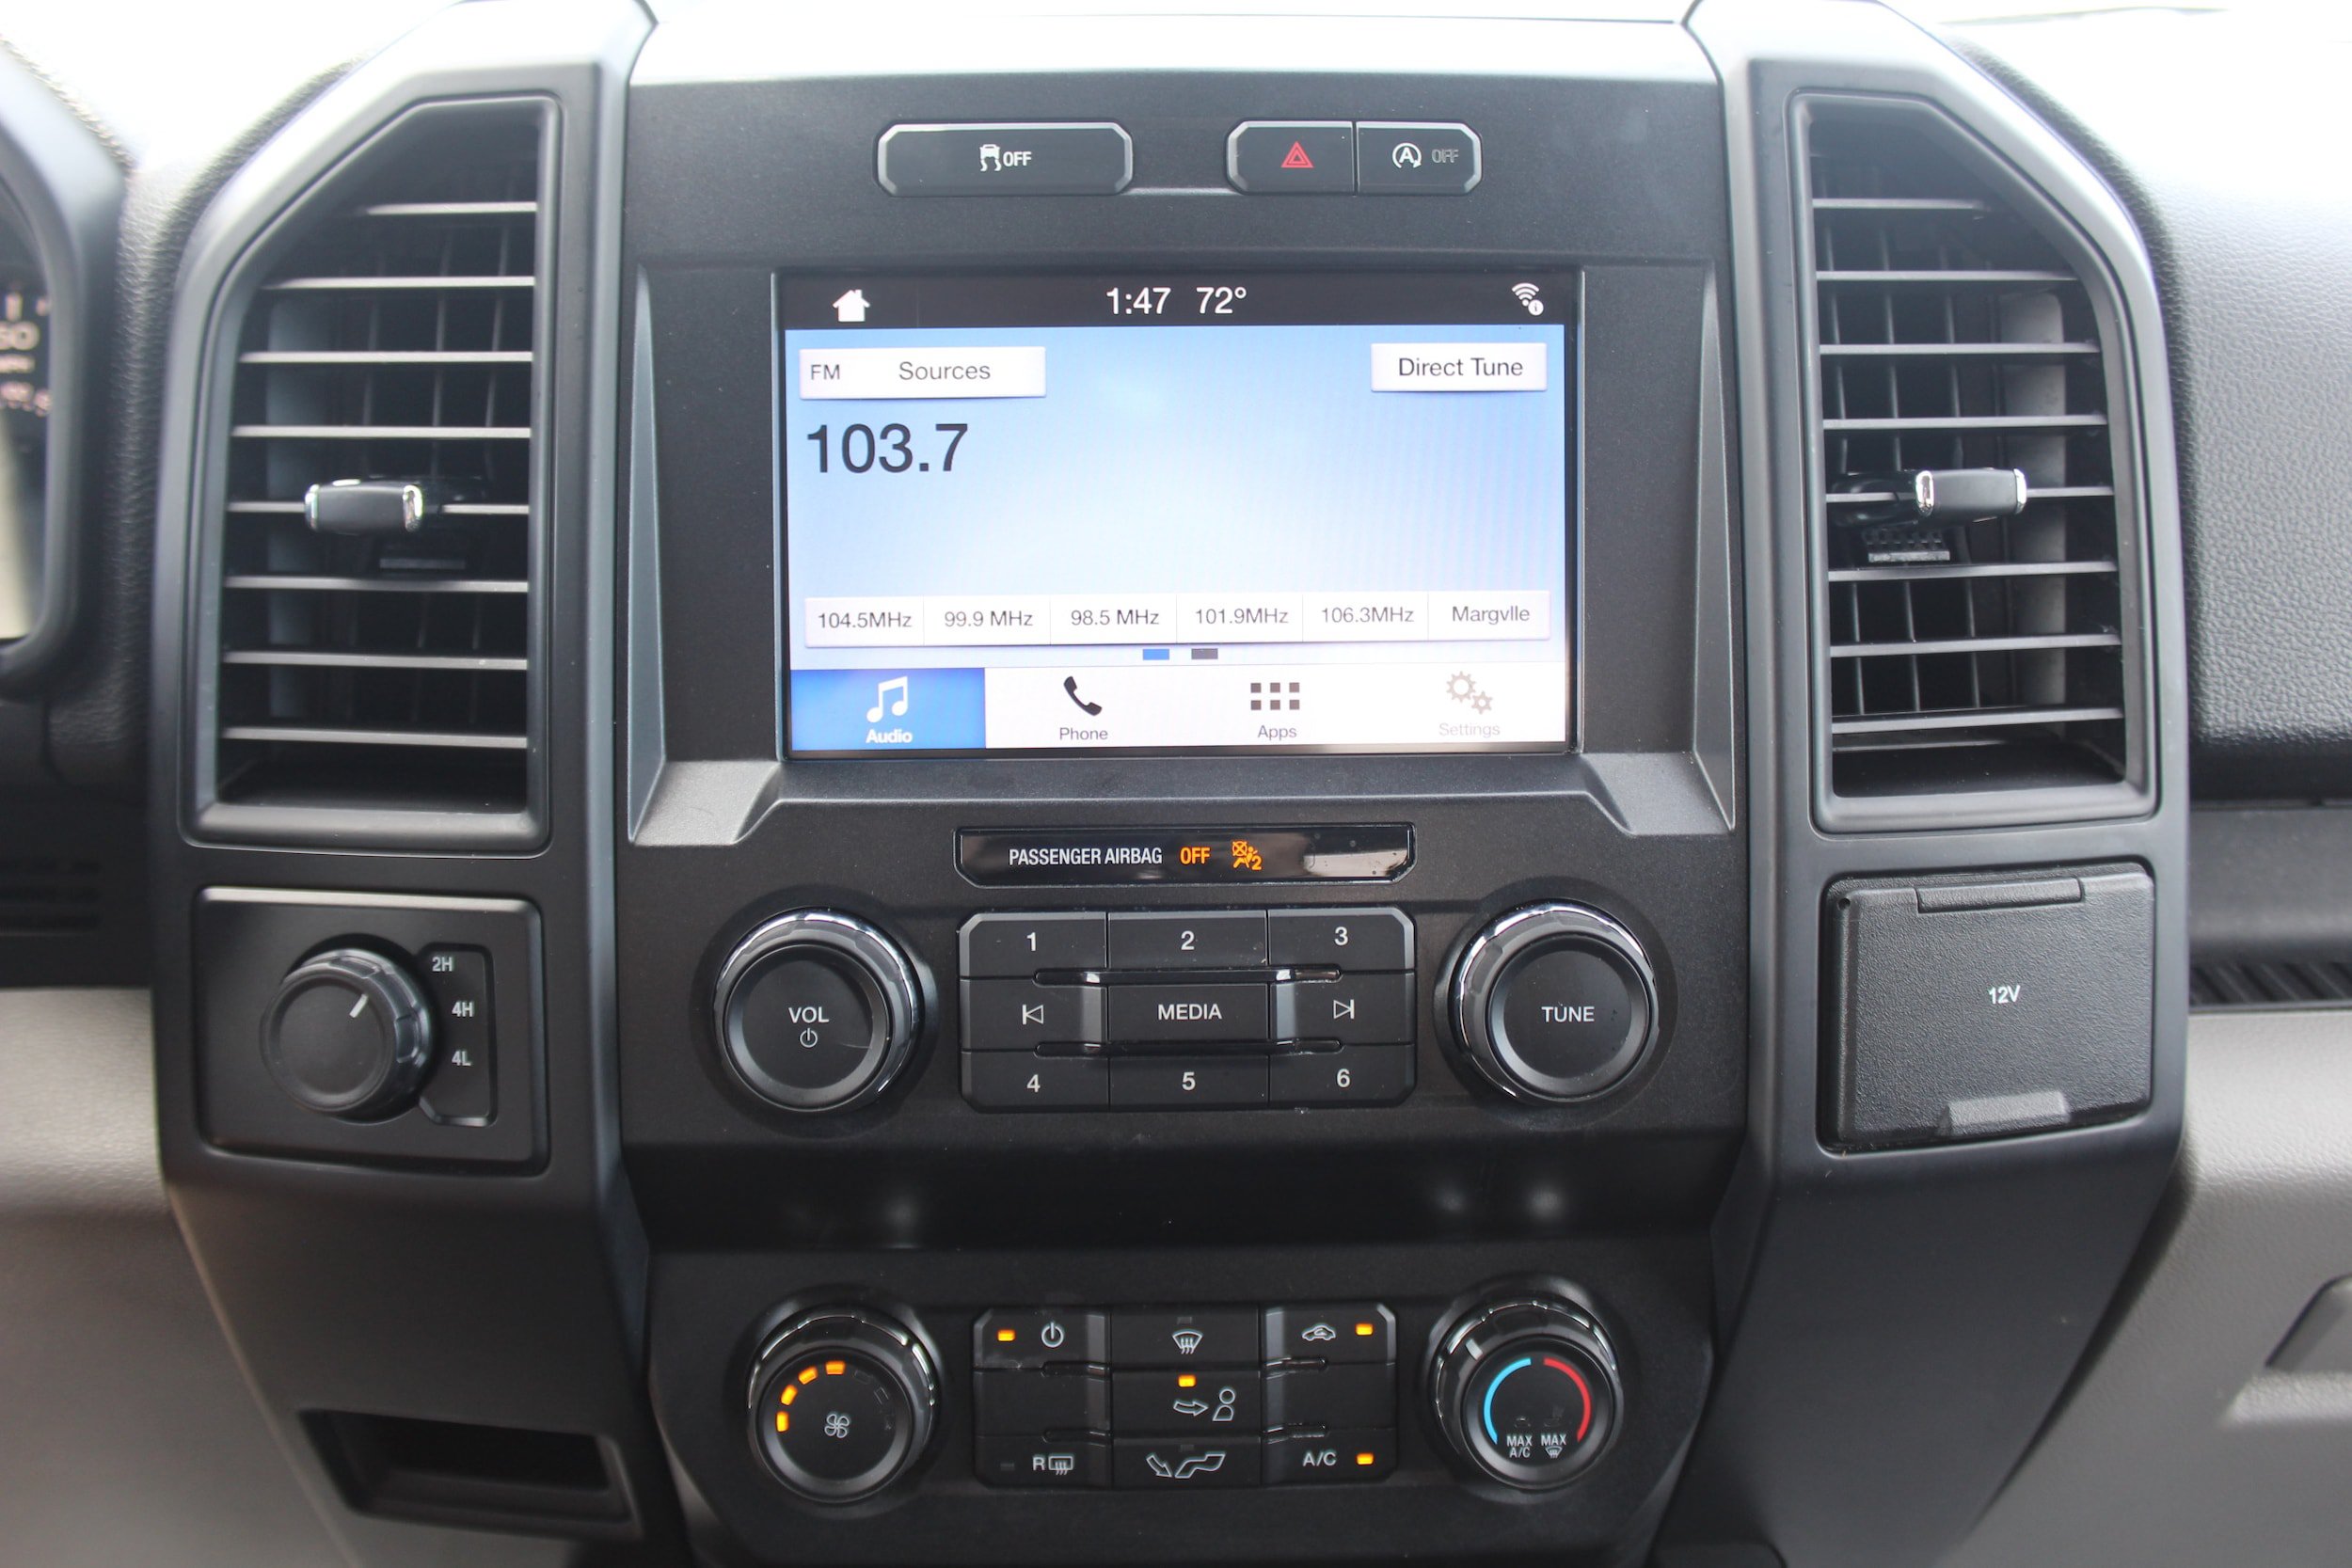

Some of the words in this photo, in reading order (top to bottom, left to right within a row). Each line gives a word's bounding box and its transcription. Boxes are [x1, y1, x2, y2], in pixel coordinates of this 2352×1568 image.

[1004, 151, 1032, 168] OFF
[1431, 149, 1459, 164] OFF
[1107, 287, 1171, 315] 1:47
[1196, 286, 1247, 315] 72°
[811, 363, 840, 380] FM
[898, 361, 991, 381] Sources
[1398, 356, 1464, 377] Direct
[1471, 356, 1523, 377] Tune
[807, 422, 969, 474] 103.7
[818, 611, 913, 629] 104.5MHz
[944, 610, 984, 627] 99.9
[990, 610, 1034, 627] MHz
[1070, 610, 1111, 626] 98.5
[1117, 610, 1160, 626] MHz
[1195, 608, 1289, 625] 101.9MHz
[1321, 607, 1415, 624] 106.3MHz
[1452, 605, 1531, 626] Margvlle
[866, 728, 914, 745] Audio
[1058, 726, 1109, 742] Phone
[1257, 723, 1297, 742] Apps
[1438, 722, 1501, 739] Settings
[1009, 847, 1102, 867] PASSENGER
[1104, 846, 1163, 865] AIRBAG
[1179, 847, 1212, 865] OFF
[1026, 932, 1038, 952] 1
[1181, 930, 1196, 951] 2
[1334, 927, 1349, 946] 3
[431, 956, 453, 973] 2H
[1987, 984, 2022, 1006] 12V
[451, 1001, 475, 1018] 4H
[787, 1006, 830, 1024] VOL
[1157, 1003, 1223, 1022] MEDIA
[1541, 1005, 1596, 1023] TUNE
[451, 1050, 472, 1067] 4L
[1026, 1074, 1041, 1094] 4
[1182, 1072, 1196, 1092] 5
[1336, 1069, 1351, 1088] 6
[1506, 1434, 1533, 1447] MAX
[1540, 1433, 1567, 1446] MAX
[1302, 1451, 1338, 1467] A/C
[1509, 1446, 1532, 1458] A/C
[1032, 1456, 1046, 1471] R
